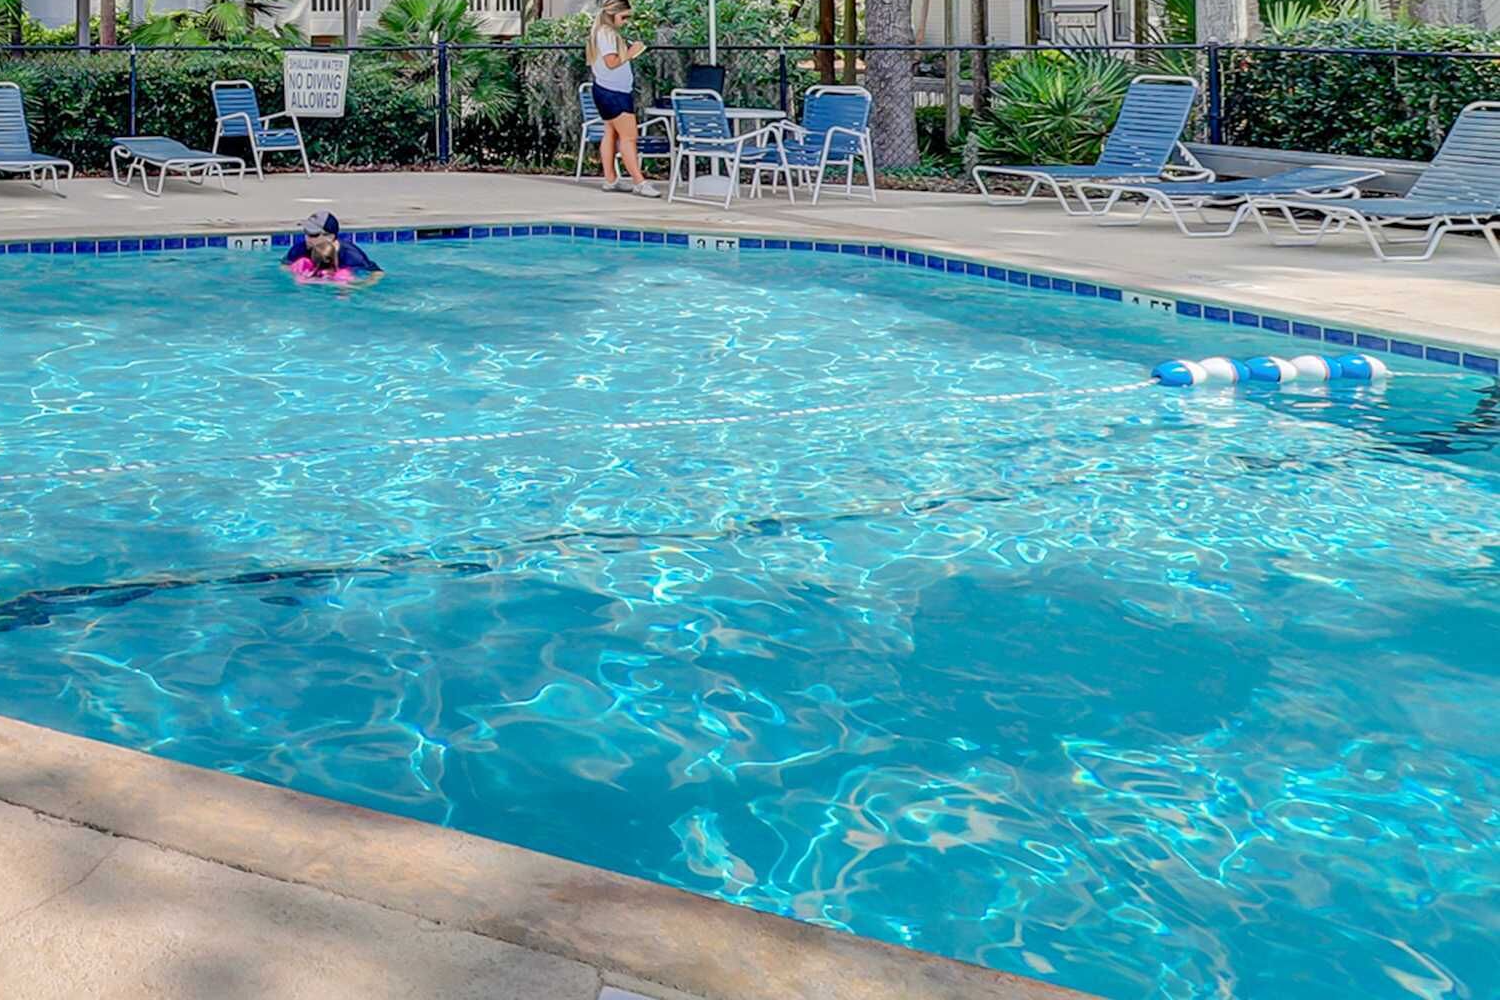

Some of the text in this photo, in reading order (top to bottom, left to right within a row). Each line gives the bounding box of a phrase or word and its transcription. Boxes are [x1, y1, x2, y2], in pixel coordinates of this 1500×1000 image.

[288, 72, 342, 90] NO DIVING
[291, 91, 340, 109] ALLOWED
